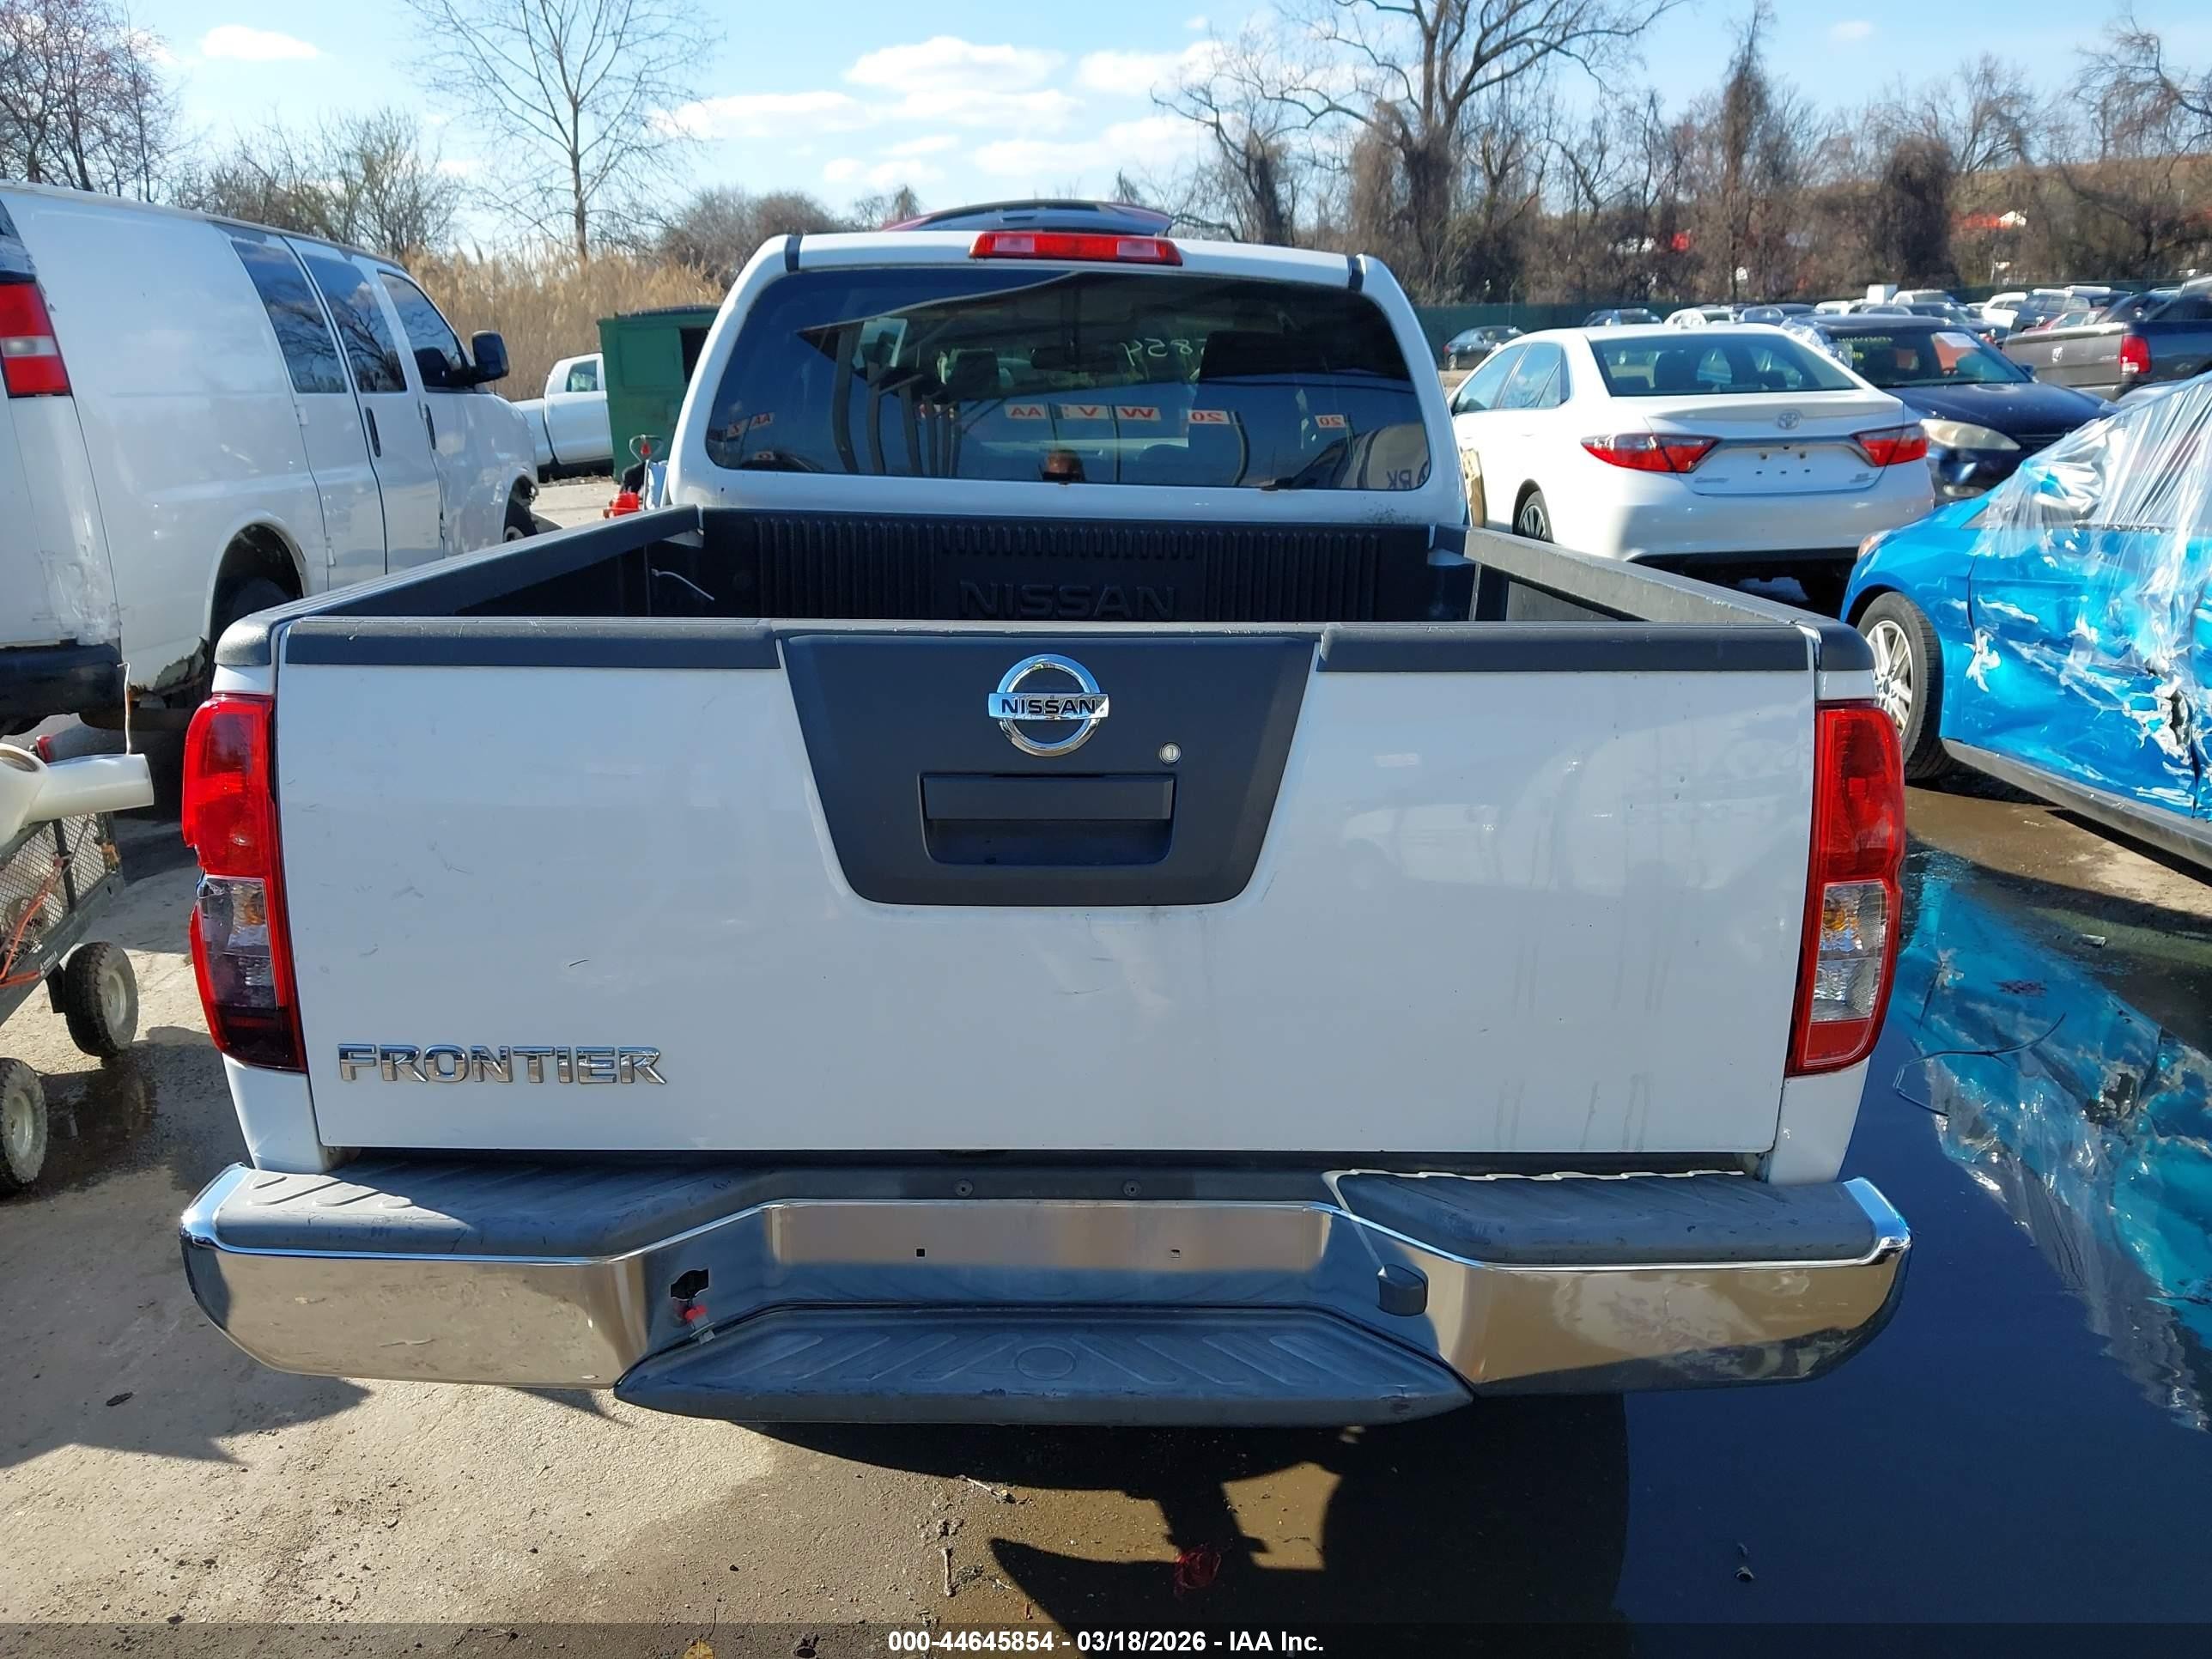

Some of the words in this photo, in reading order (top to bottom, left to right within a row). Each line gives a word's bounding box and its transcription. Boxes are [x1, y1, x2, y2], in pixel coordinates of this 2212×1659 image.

[959, 580, 1176, 619] NISSAN
[1001, 699, 1096, 714] NISSAN
[337, 1043, 667, 1085] FRONTIER
